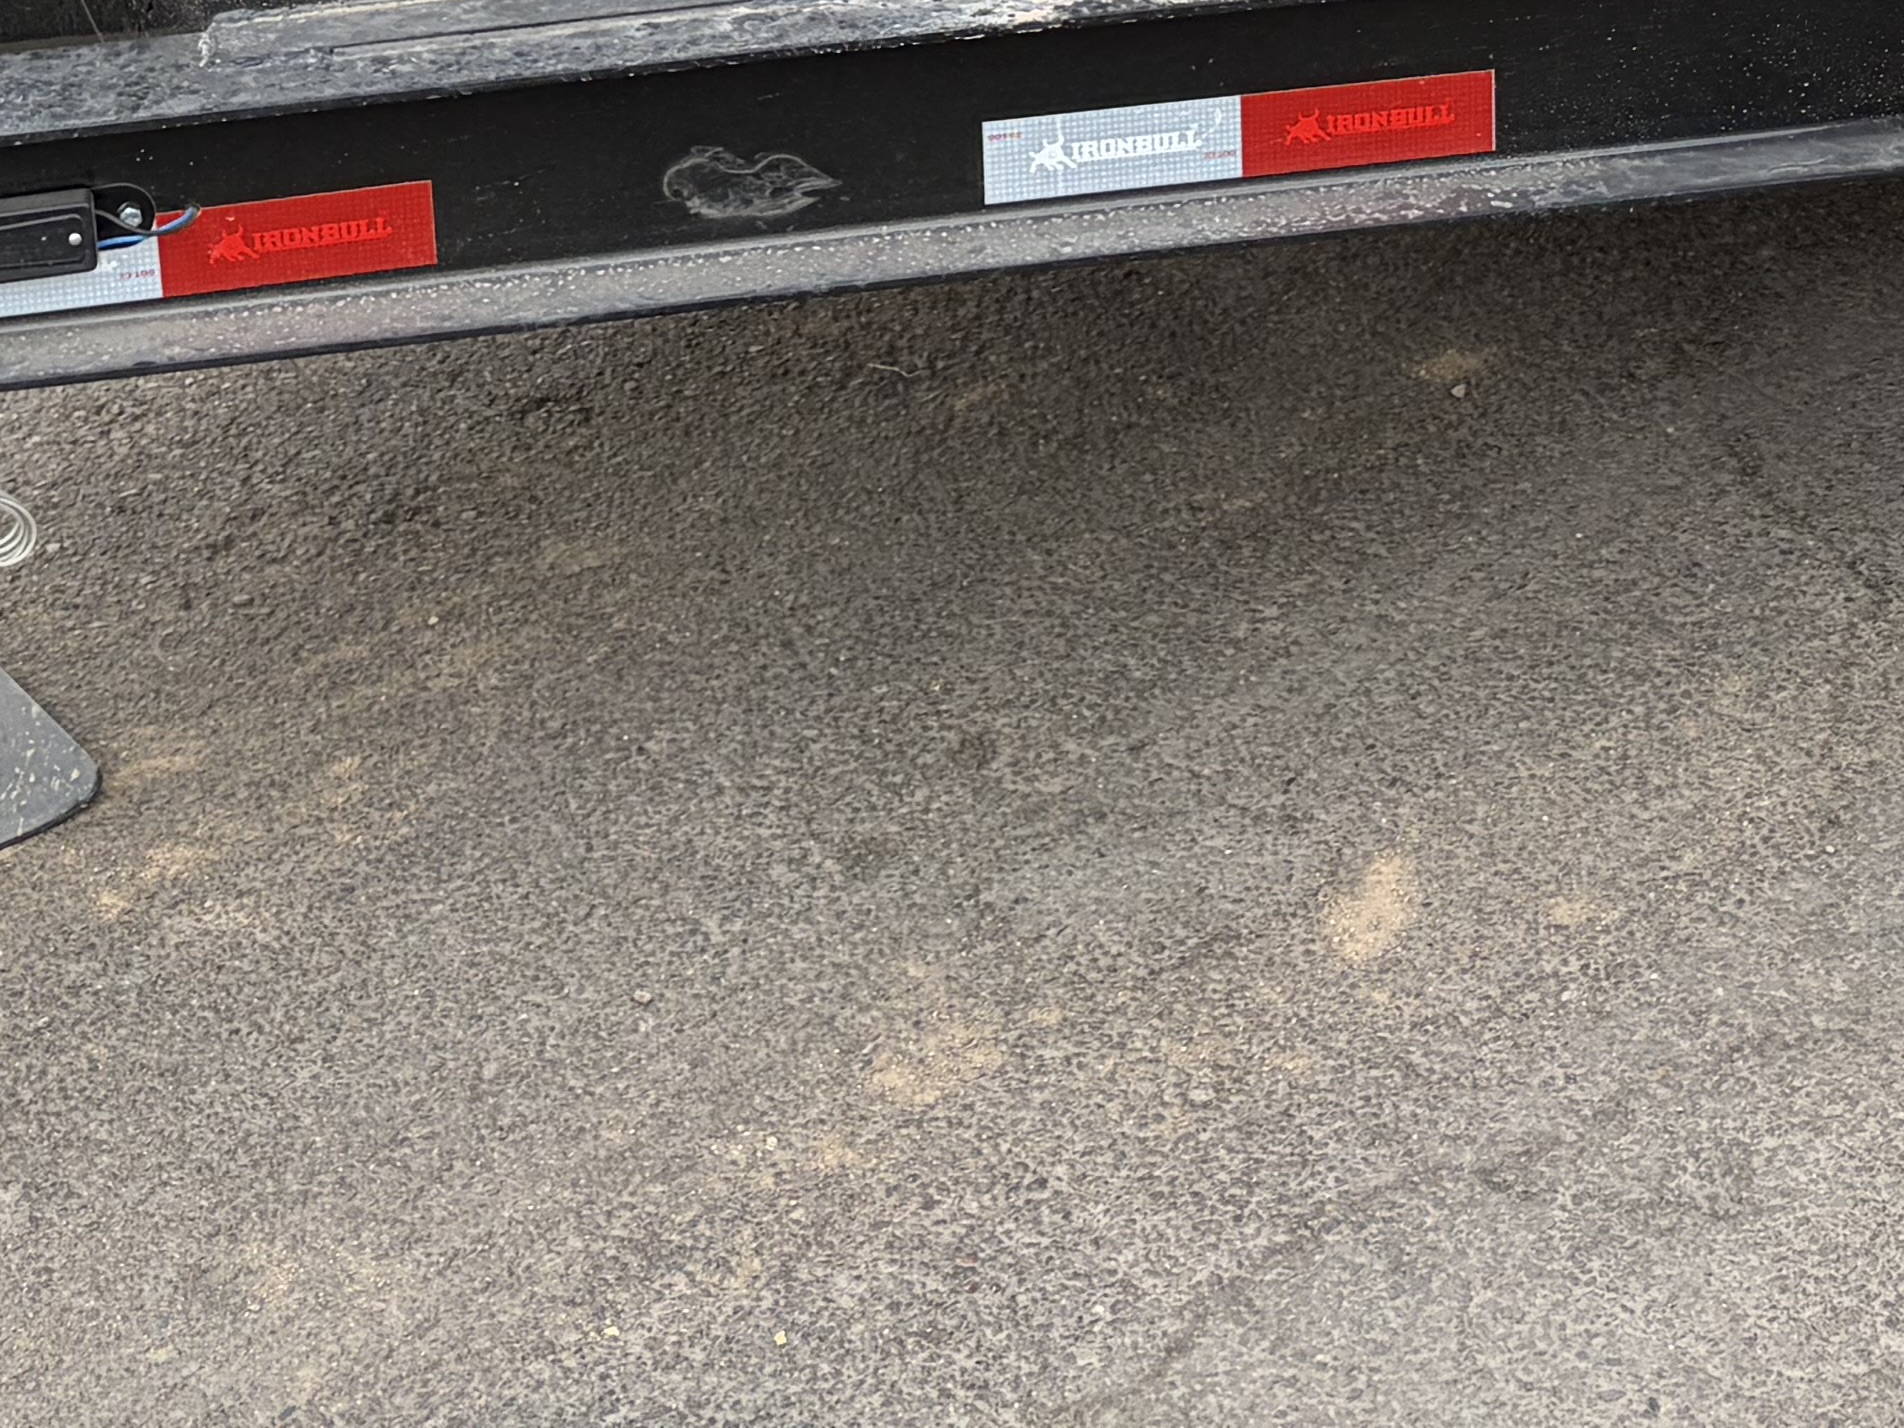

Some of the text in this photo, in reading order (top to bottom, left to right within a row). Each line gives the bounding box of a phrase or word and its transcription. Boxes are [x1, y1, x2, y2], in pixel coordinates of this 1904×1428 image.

[1326, 101, 1456, 136] IRONBULL
[1070, 124, 1204, 163] IRONBULL
[252, 217, 393, 253] IRONBULL
